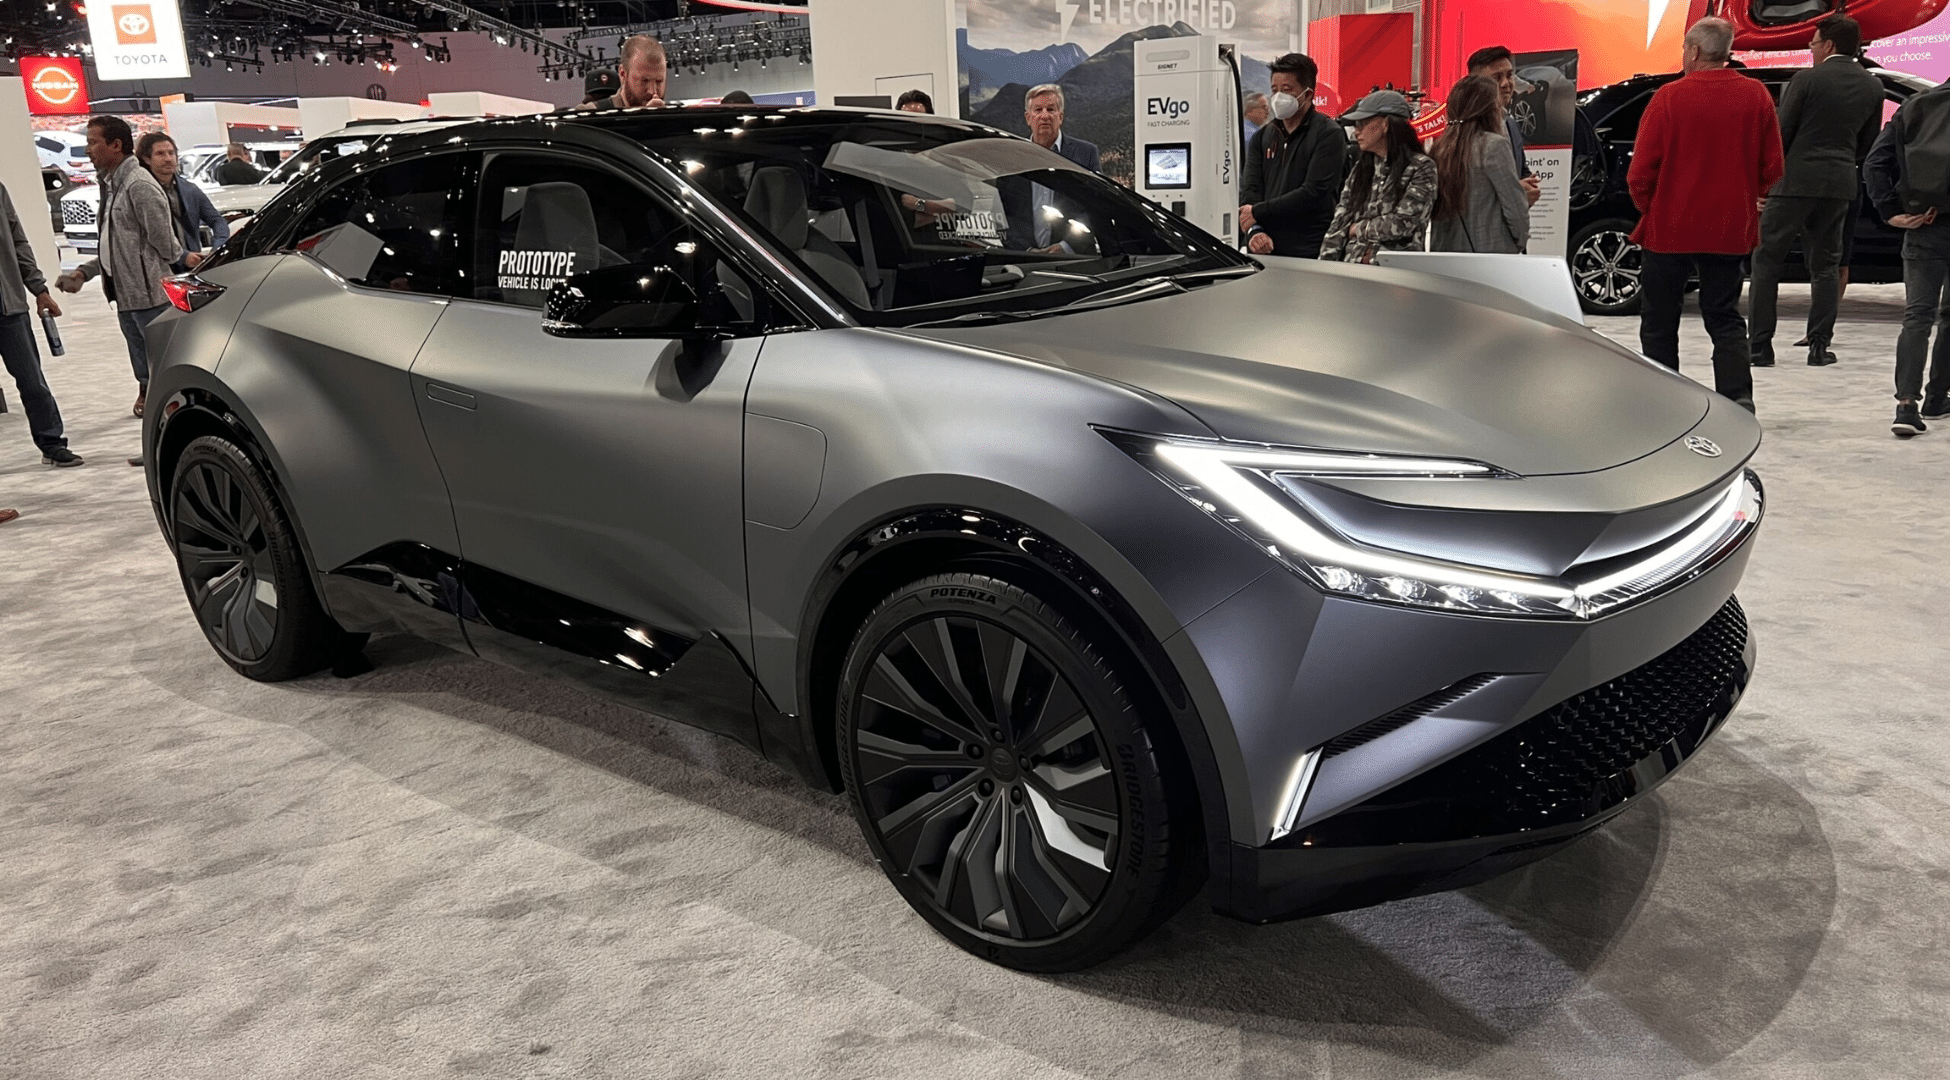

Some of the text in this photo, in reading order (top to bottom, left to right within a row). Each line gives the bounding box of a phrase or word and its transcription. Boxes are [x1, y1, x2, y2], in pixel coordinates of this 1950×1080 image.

[1089, 0, 1236, 30] ELECTRIFIED
[1896, 37, 1907, 46] an
[114, 54, 168, 65] TOYOTA
[1884, 54, 1898, 66] you
[1148, 97, 1189, 119] EVgo
[1223, 150, 1231, 185] EVgo
[1547, 159, 1559, 167] on
[498, 250, 576, 276] PROTOTYPE
[498, 276, 529, 289] VEHICLE
[530, 277, 539, 290] IS
[930, 588, 997, 605] POTENZA
[1116, 743, 1145, 879] BRIDGESTONE
